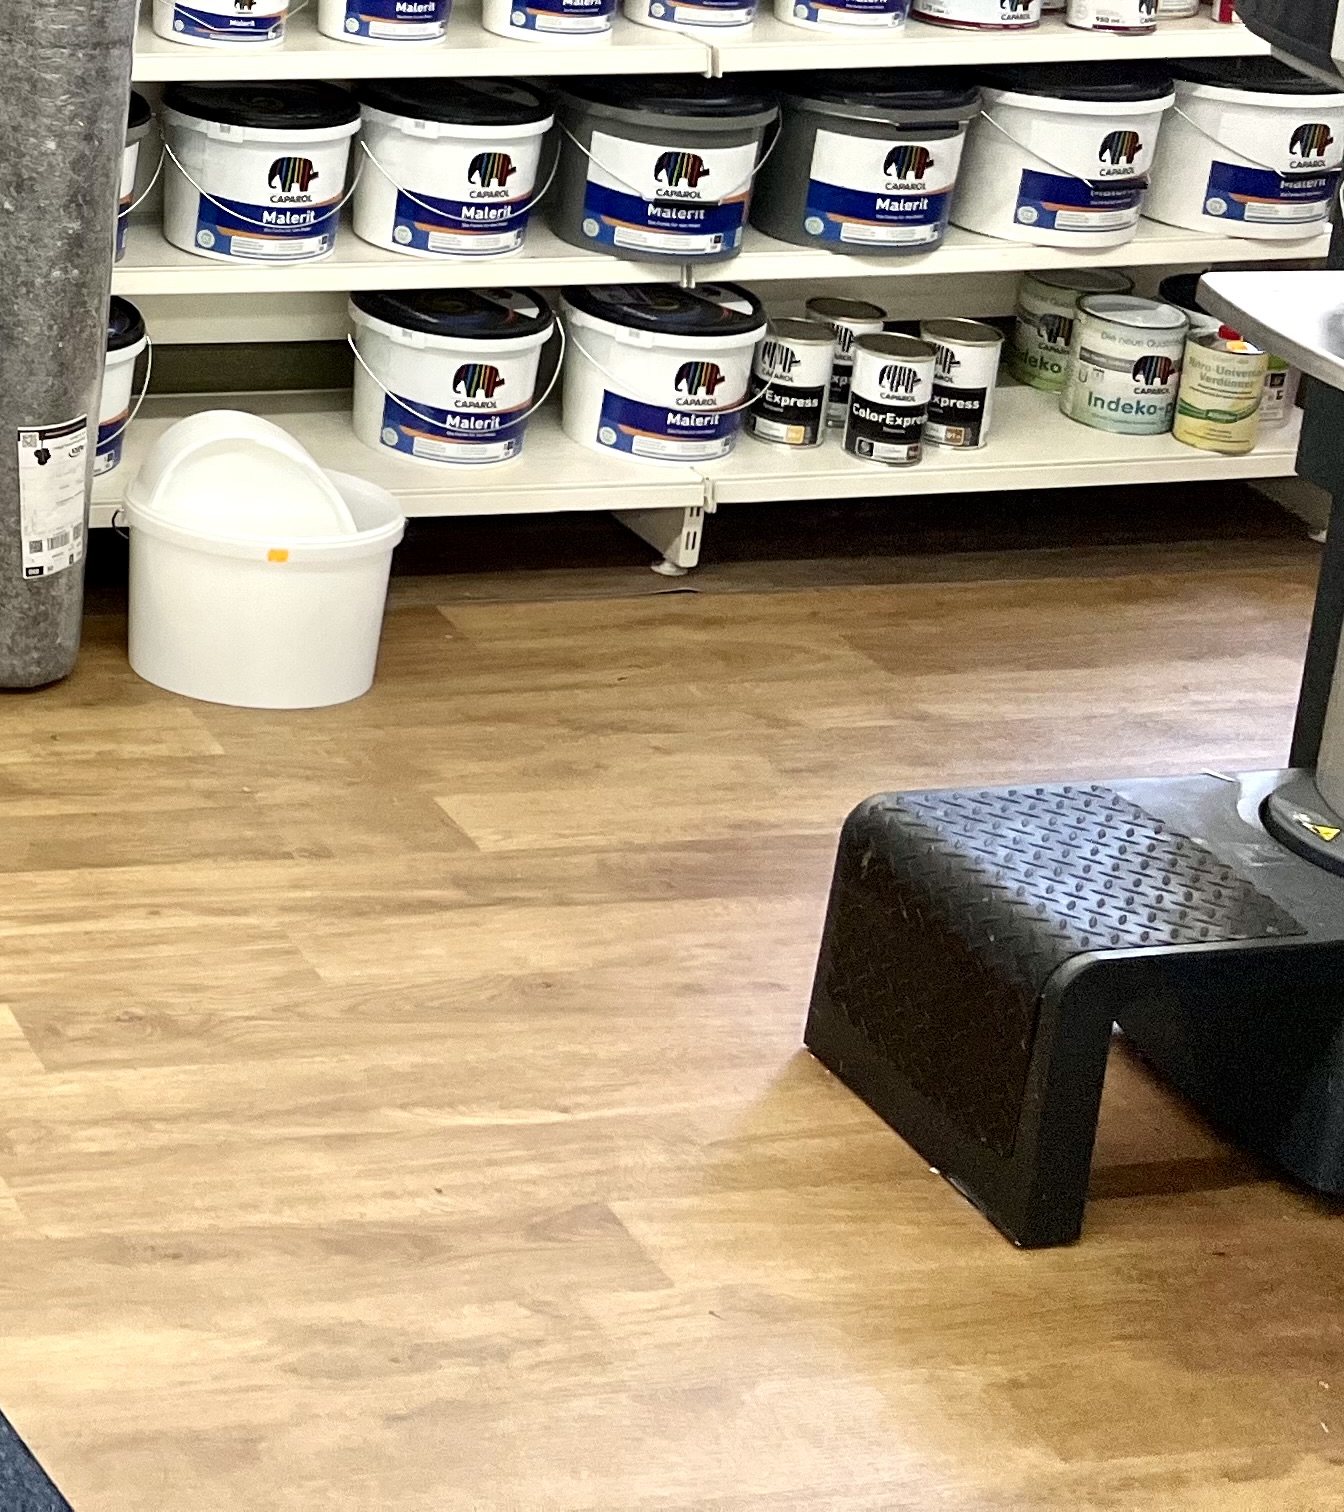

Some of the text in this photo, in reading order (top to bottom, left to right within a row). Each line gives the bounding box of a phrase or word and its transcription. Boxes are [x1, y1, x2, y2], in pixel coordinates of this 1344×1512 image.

[395, 0, 436, 13] Malerit
[1290, 159, 1326, 169] CAPAROL
[1099, 167, 1135, 177] CAPAROL
[885, 182, 927, 191] CAPAROL
[270, 194, 312, 204] CAPAROL
[469, 189, 510, 199] CAPAROL
[656, 189, 702, 199] CAPAROL
[875, 196, 929, 213] Malerit
[262, 208, 316, 226] Malerit
[461, 204, 513, 221] Malerit
[647, 203, 705, 221] Malerit
[1133, 387, 1171, 396] CAPAROL
[675, 397, 717, 407] CAPAROL
[880, 392, 917, 403] CAPAROL
[453, 399, 498, 409] CAPAROL
[445, 414, 500, 430] Malerit
[666, 411, 720, 427] Malerit
